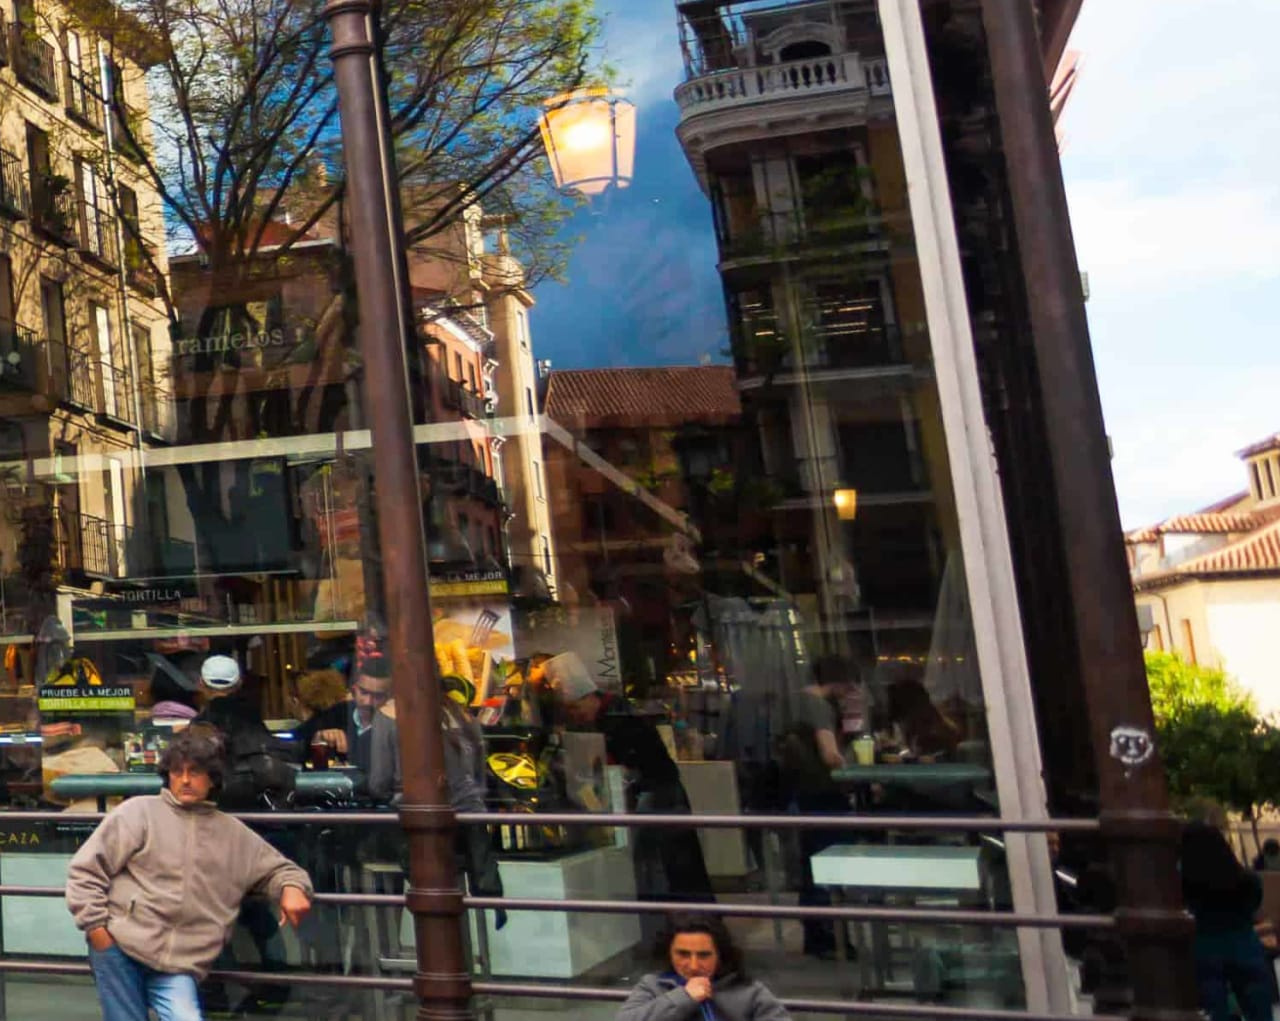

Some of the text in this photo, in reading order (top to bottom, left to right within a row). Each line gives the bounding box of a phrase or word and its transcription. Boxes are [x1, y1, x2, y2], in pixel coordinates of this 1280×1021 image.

[121, 589, 182, 602] TORTILLA
[42, 688, 131, 697] PRUEBE LA MEJOR
